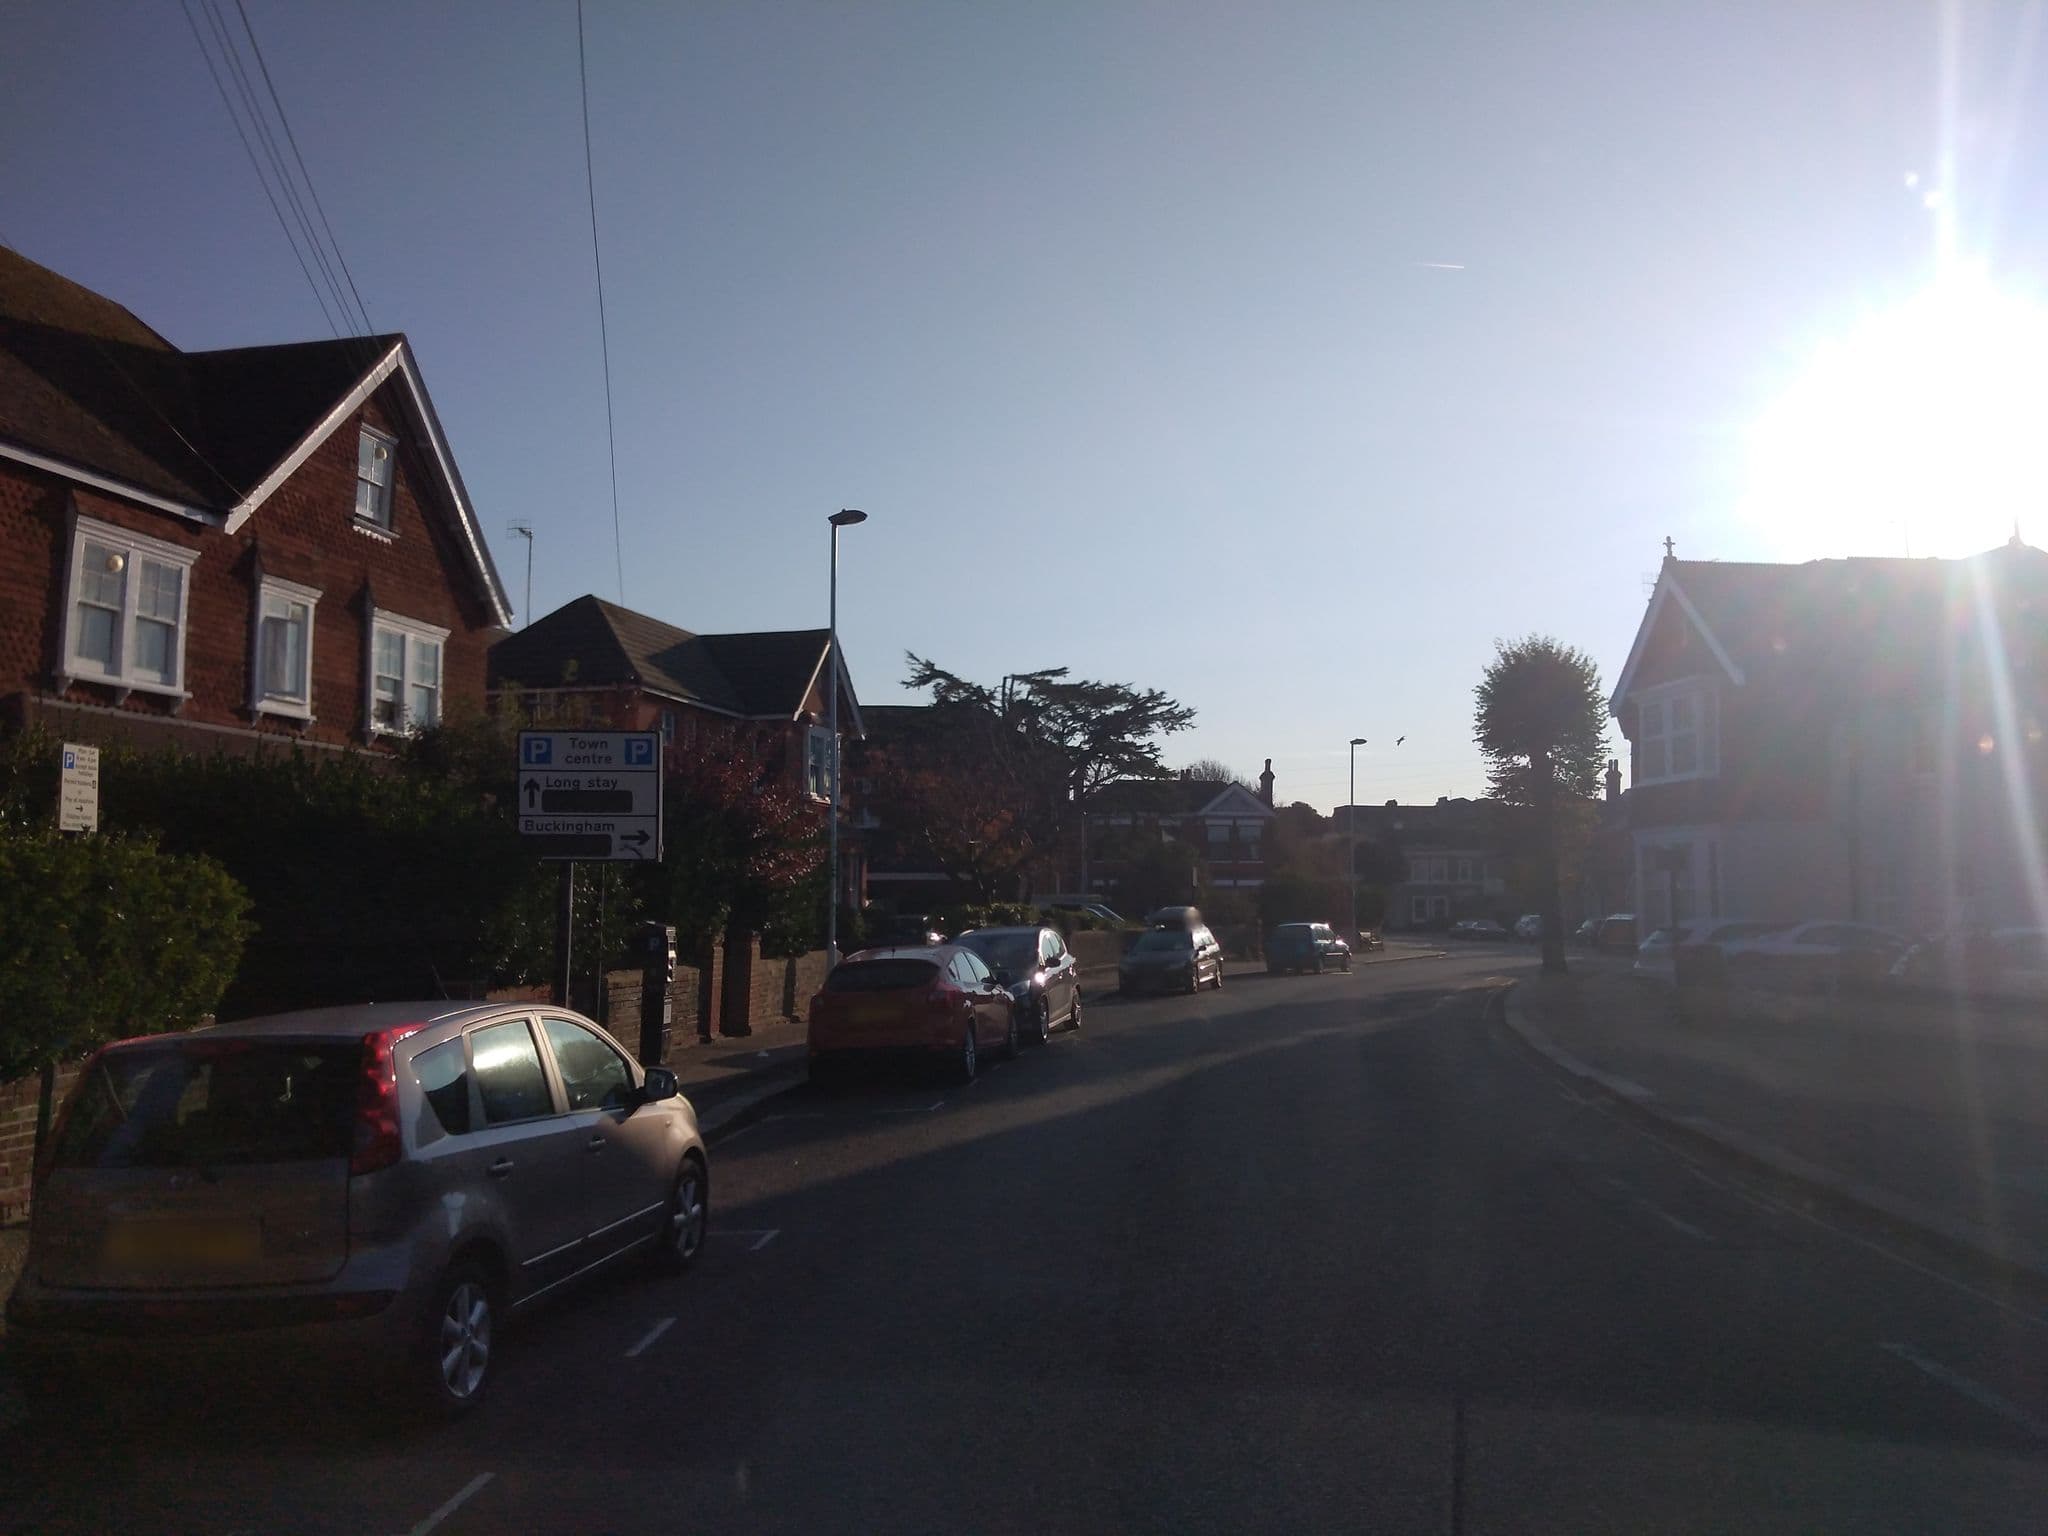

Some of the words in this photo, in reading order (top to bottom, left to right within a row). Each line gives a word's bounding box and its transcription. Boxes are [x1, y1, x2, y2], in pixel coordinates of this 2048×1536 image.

[530, 739, 548, 762] P
[568, 737, 608, 750] Town
[564, 752, 613, 765] centre
[630, 740, 650, 763] P
[66, 753, 74, 768] P
[545, 775, 580, 790] Long
[587, 776, 618, 790] stay
[524, 819, 616, 834] Buckingham
